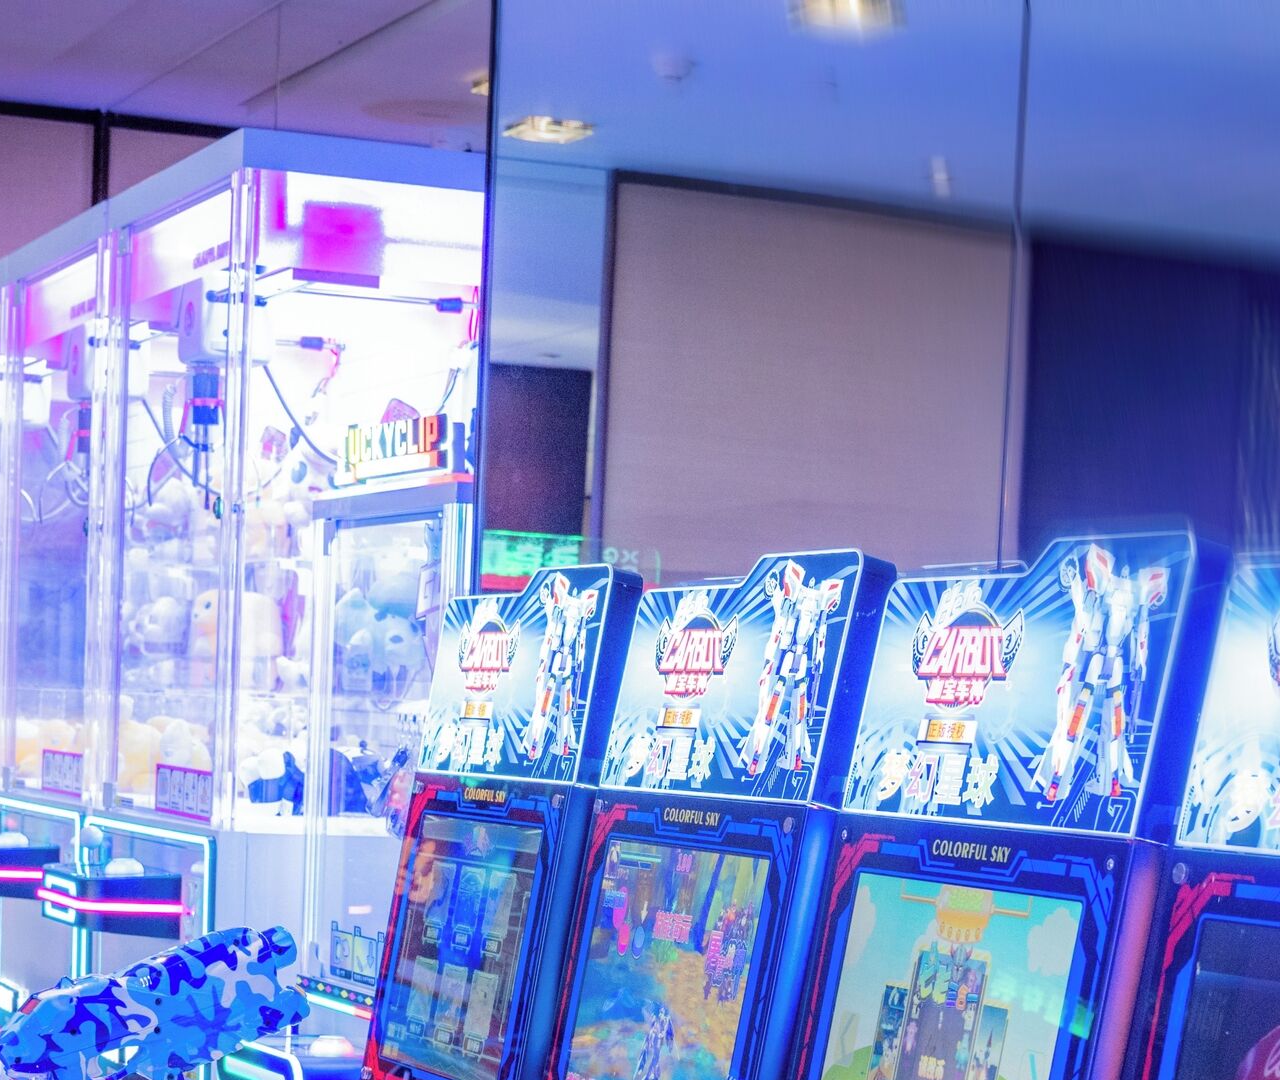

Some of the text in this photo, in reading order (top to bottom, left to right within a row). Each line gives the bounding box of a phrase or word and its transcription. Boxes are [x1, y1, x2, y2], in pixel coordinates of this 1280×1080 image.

[917, 625, 1007, 681] CARBOT
[876, 749, 1000, 809] 梦幻星球
[464, 787, 507, 803] COLORFUL SKY
[663, 807, 720, 827] COLORFUL SKY
[932, 839, 1012, 863] COLORFUL SKY
